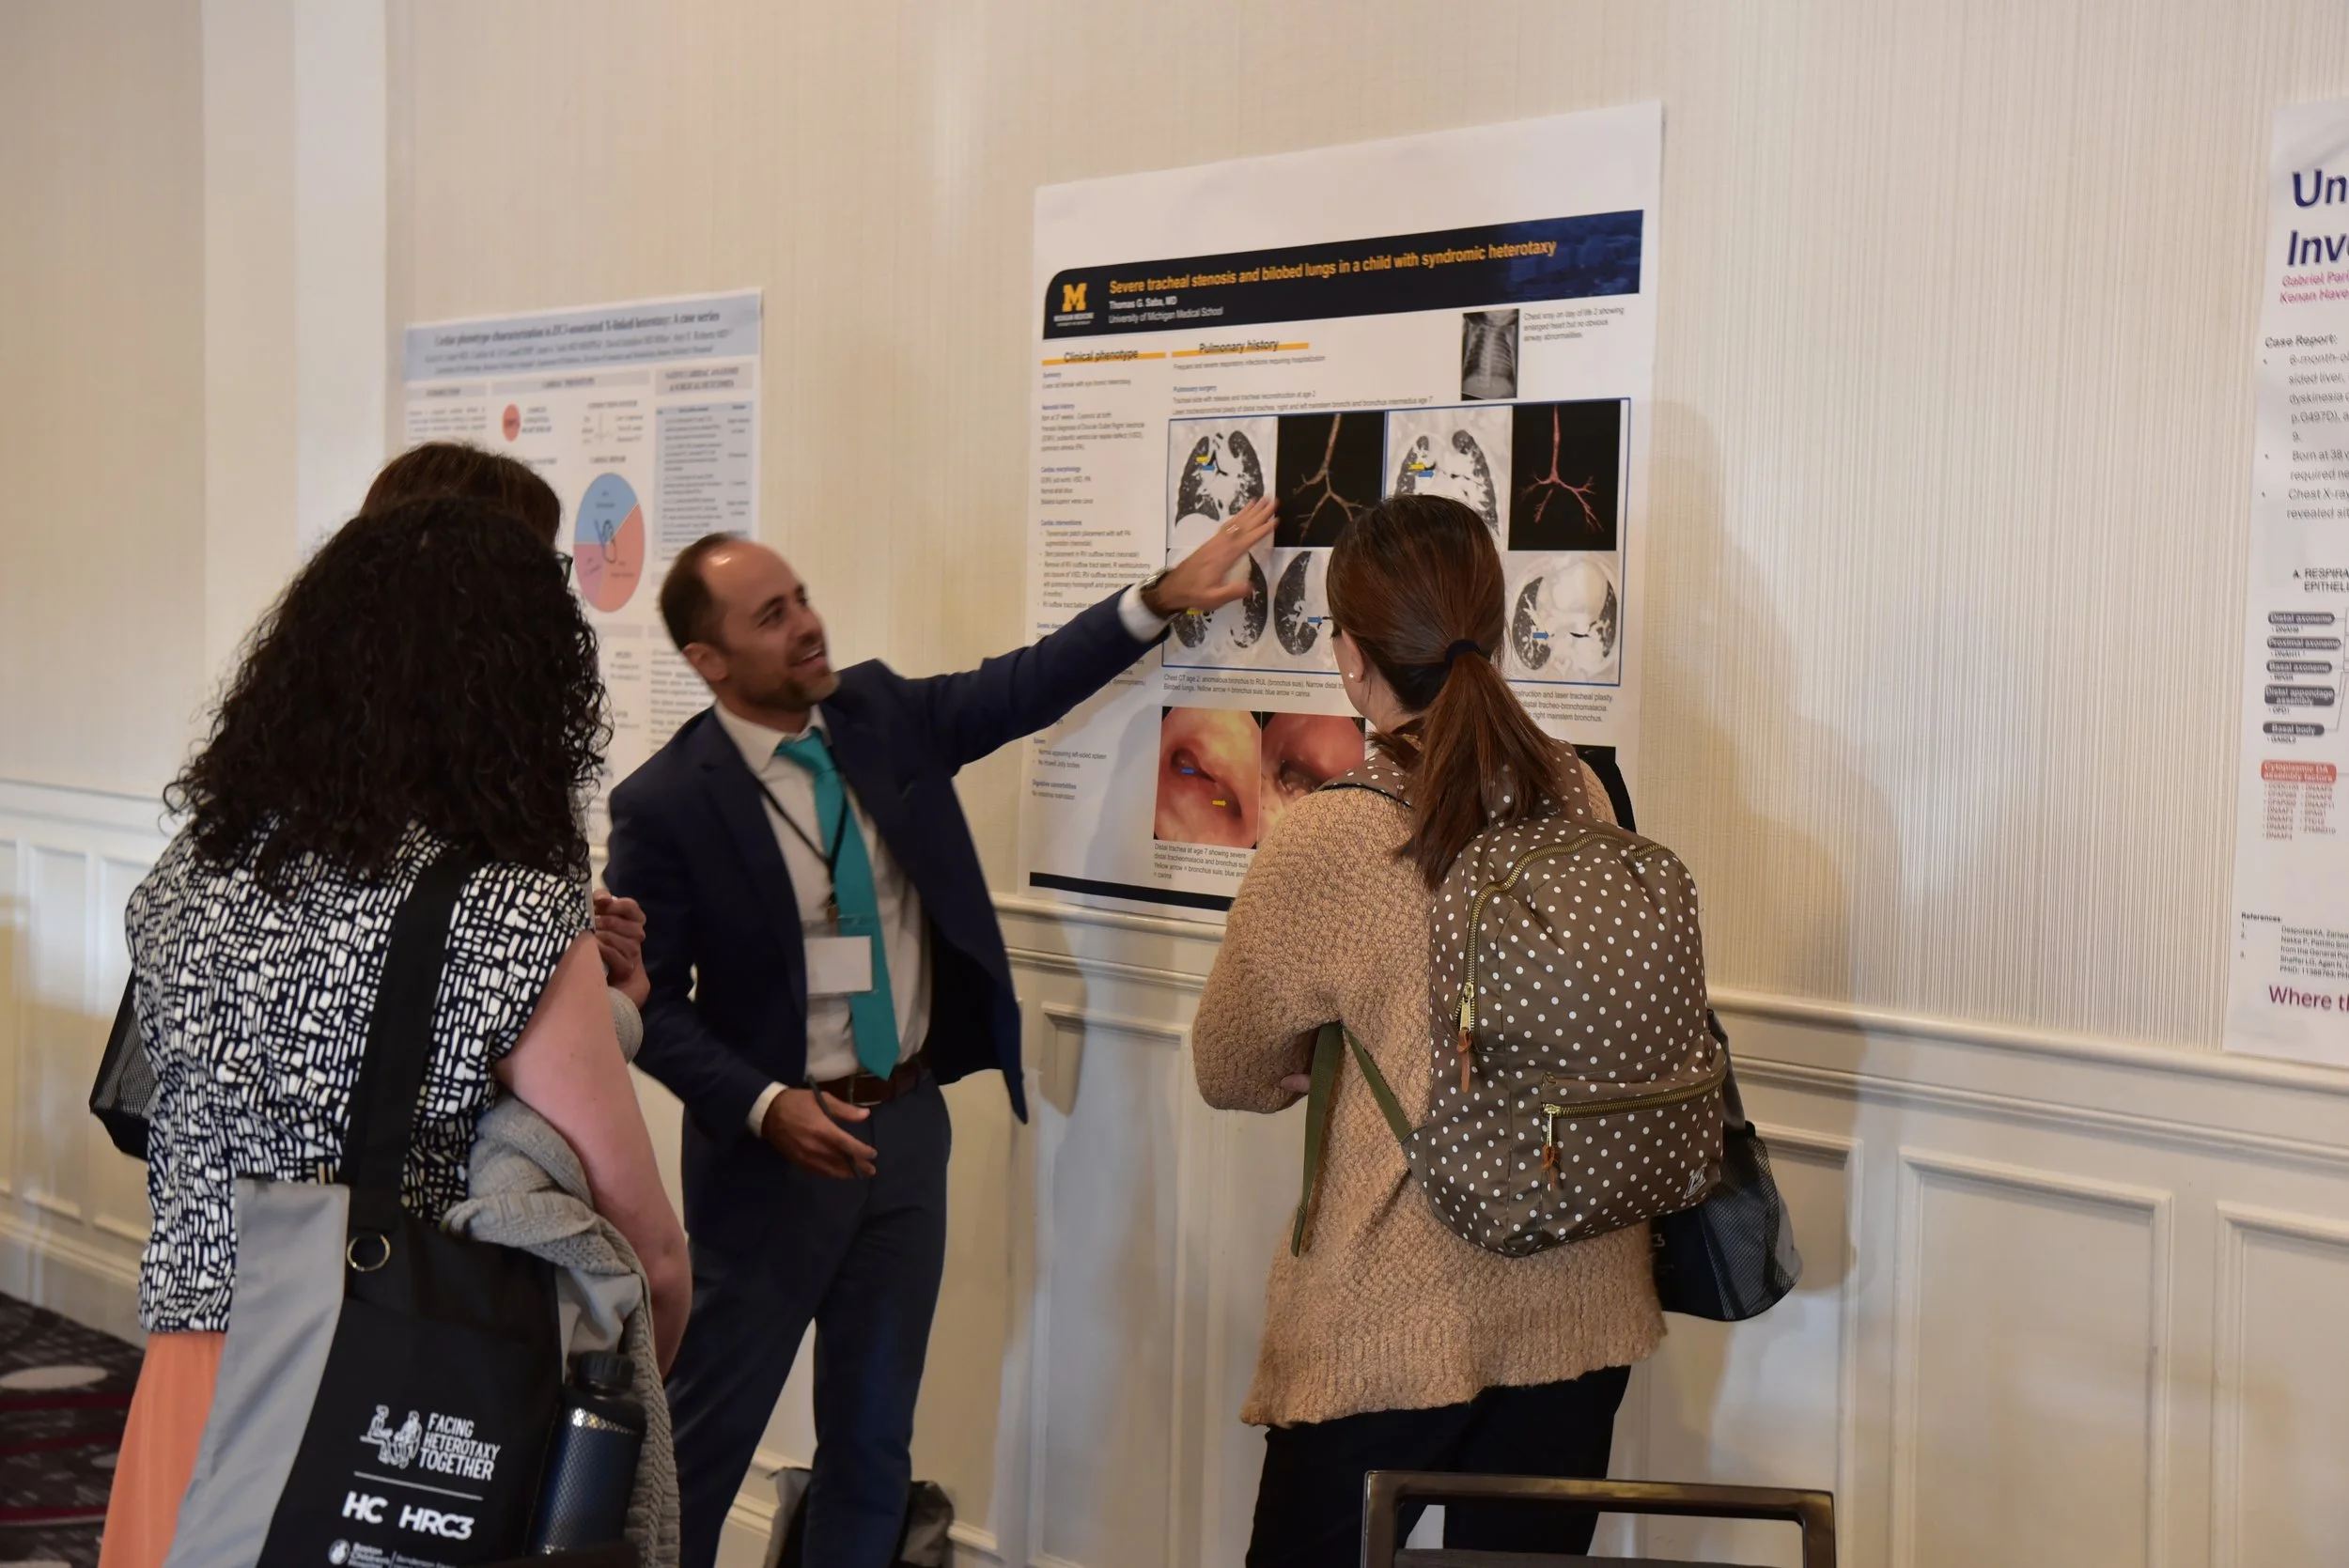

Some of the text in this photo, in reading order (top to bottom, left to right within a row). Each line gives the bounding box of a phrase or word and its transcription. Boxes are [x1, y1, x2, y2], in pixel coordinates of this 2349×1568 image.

[2287, 228, 2349, 268] Inv
[1110, 241, 1557, 294] Severe tracheal stenosis and bilobed lungs in a child with syndromic heterotaxy
[2281, 272, 2325, 287] Gabriel
[1062, 283, 1087, 313] M
[1109, 300, 1135, 309] Thomas
[1136, 298, 1144, 307] G.
[1165, 296, 1177, 305] MD
[2279, 290, 2316, 304] Kenan
[1108, 306, 1223, 323] University of Michigan Medical School
[1599, 307, 1625, 316] showing
[1199, 339, 1280, 354] Pulmonary history
[2264, 334, 2338, 349] Case Report:
[1064, 349, 1139, 363] Clinical phenotype
[2289, 372, 2318, 385] sided
[2289, 392, 2343, 407] dyskinesia
[2293, 448, 2342, 461] Born at 38
[2291, 470, 2336, 482] required
[2288, 488, 2321, 500] Chest
[2287, 506, 2335, 519] revealed
[2271, 613, 2294, 622] Distal
[2269, 638, 2303, 647] Proximal
[2269, 661, 2292, 670] Basal
[1543, 691, 1553, 699] and
[1570, 691, 1593, 701] tracheal
[2265, 686, 2289, 695] Distal
[1533, 712, 1546, 721] right
[1547, 712, 1573, 721] mainstem
[2272, 723, 2316, 736] Basal body
[1155, 843, 1168, 851] Distal
[1169, 845, 1187, 853] trachea
[1208, 848, 1229, 859] showing
[1216, 859, 1238, 867] bronchus
[1188, 865, 1212, 875] bronchus
[2241, 911, 2283, 923] References:
[2280, 945, 2296, 954] from
[2297, 946, 2309, 955] the
[2310, 948, 2336, 957] General
[2279, 965, 2300, 974] PMID:
[2269, 984, 2332, 1011] Where
[427, 1412, 474, 1438] FACING
[423, 1432, 501, 1462] HETEROTAXY
[419, 1447, 494, 1482] TOGETHER
[342, 1490, 475, 1540] HC HRC3
